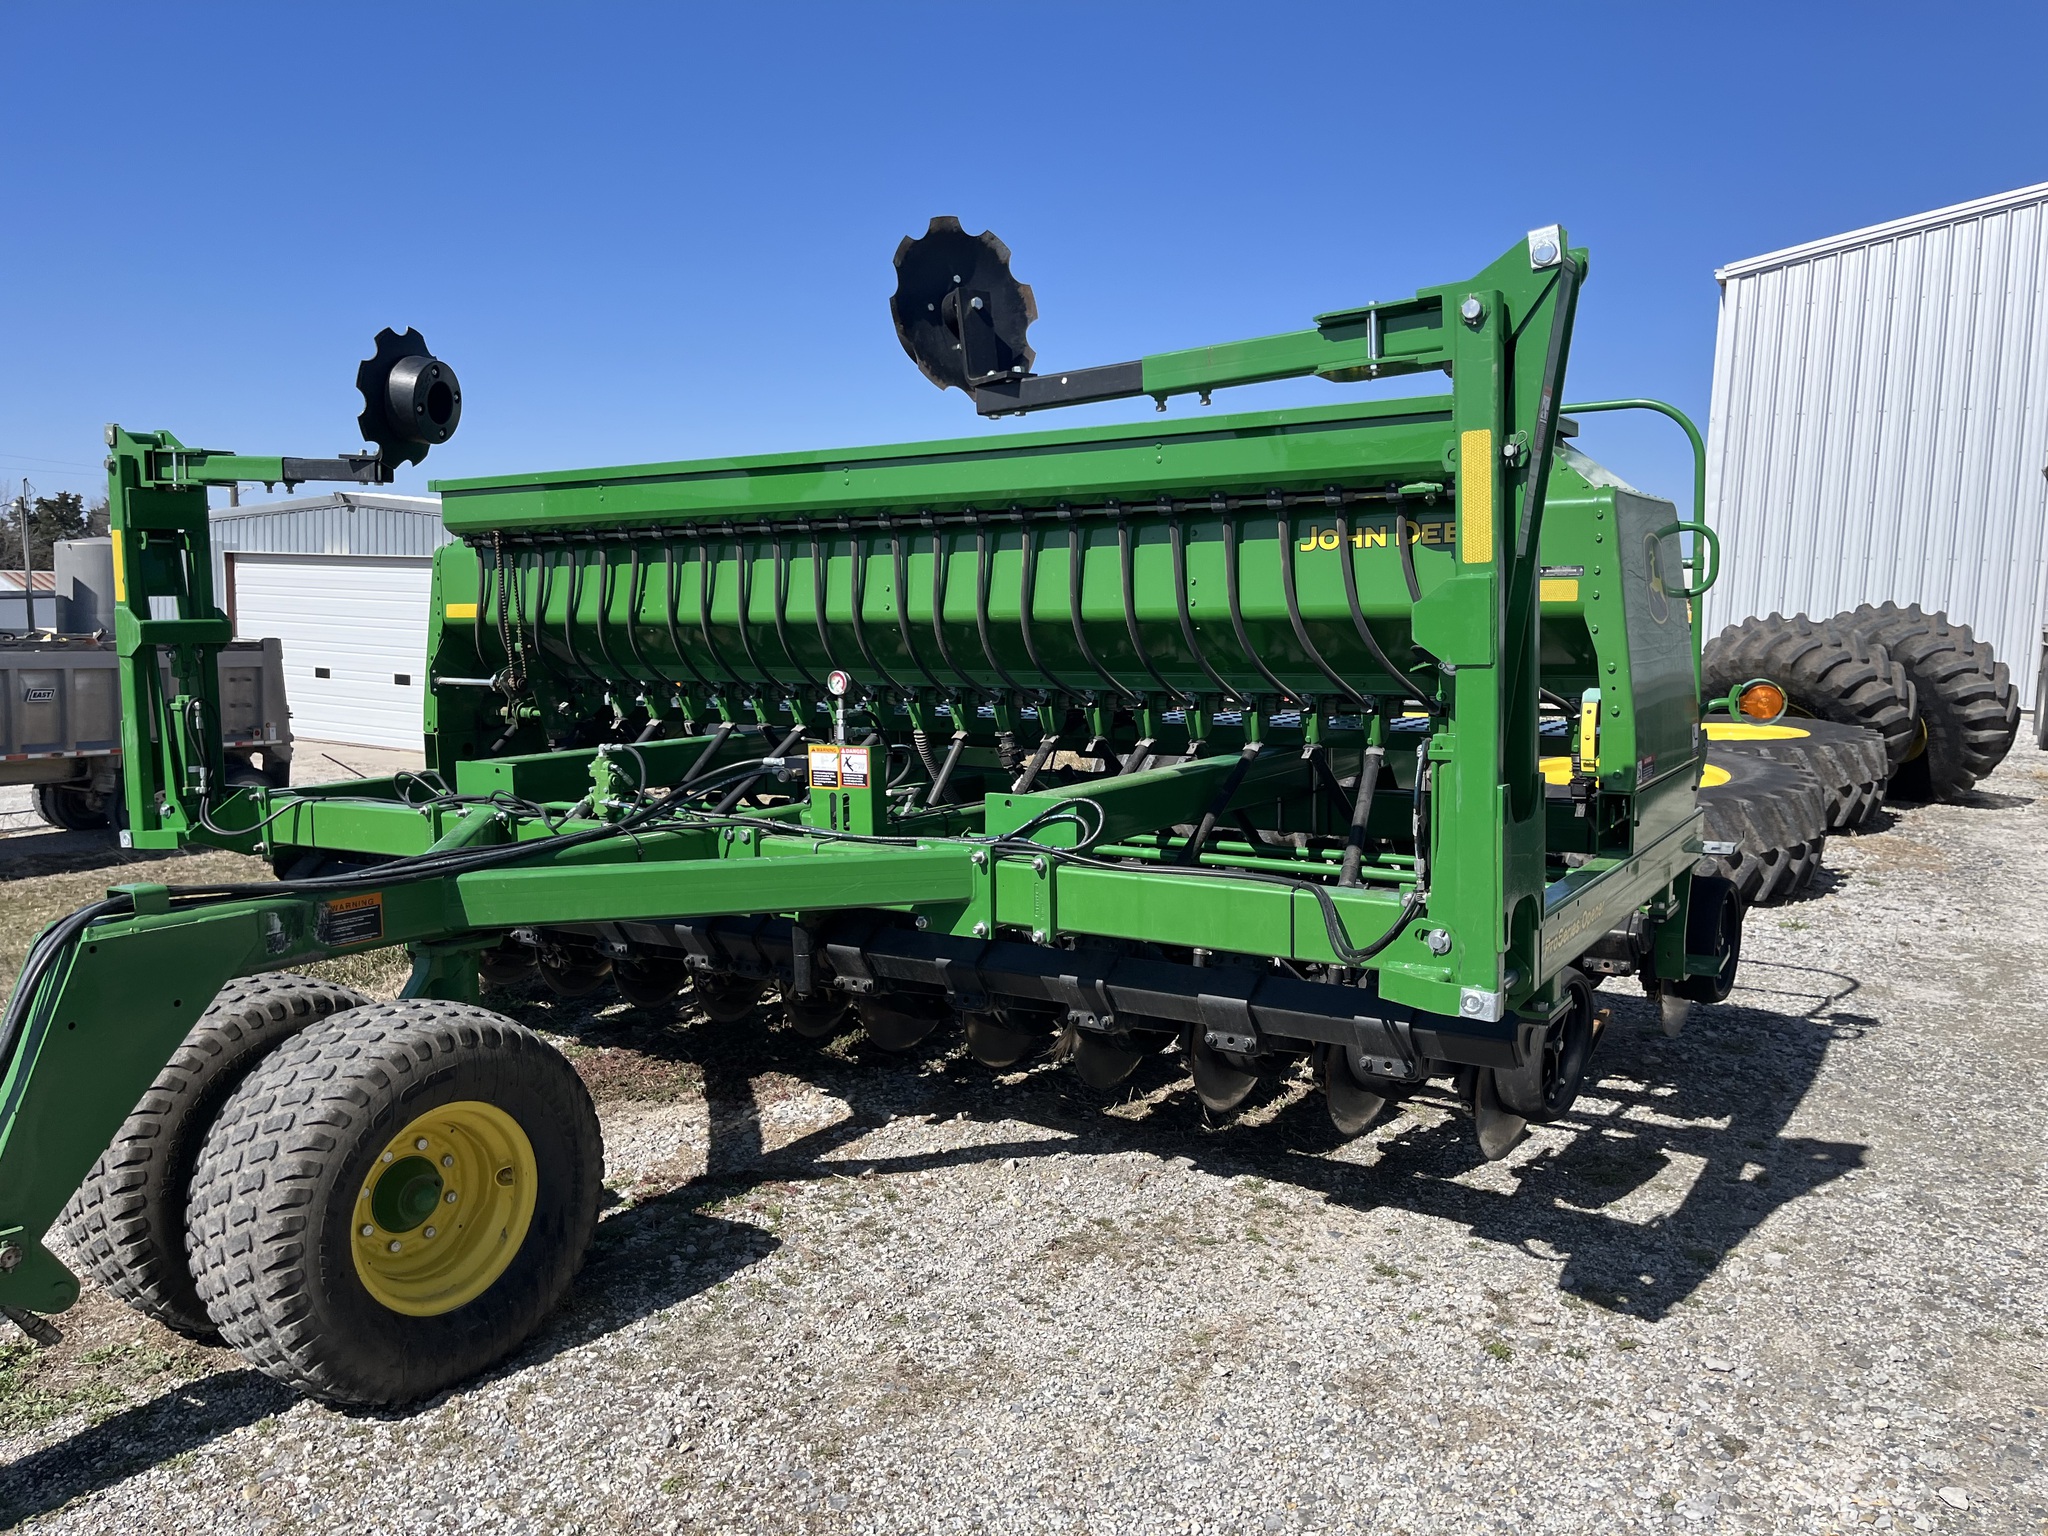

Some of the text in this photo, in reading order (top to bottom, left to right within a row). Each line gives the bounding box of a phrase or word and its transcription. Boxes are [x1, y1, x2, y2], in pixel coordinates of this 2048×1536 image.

[1300, 520, 1456, 552] JOHN DEE
[330, 898, 375, 912] WARNING
